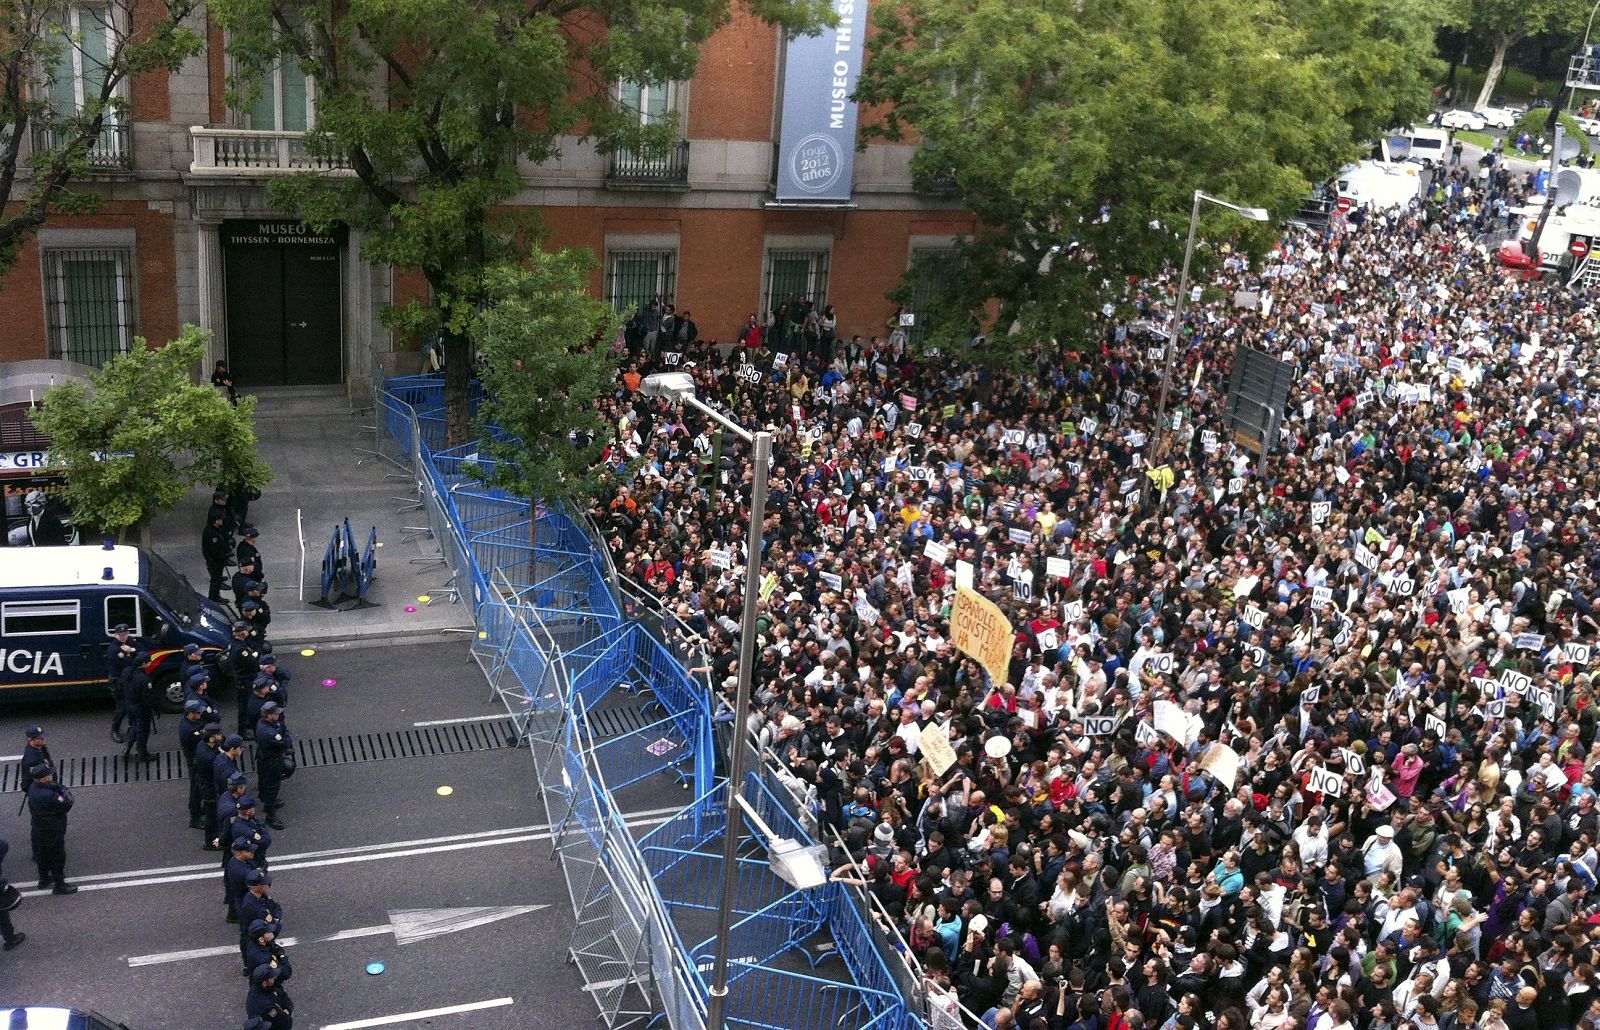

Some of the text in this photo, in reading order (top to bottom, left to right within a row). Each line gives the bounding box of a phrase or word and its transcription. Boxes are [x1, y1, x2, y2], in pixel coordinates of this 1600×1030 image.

[830, 61, 848, 128] MUSEO
[802, 145, 826, 159] 1992
[801, 155, 829, 170] 2012
[802, 167, 831, 181] años
[259, 224, 306, 235] MUSEO
[231, 236, 270, 244] THYSSEN
[278, 236, 335, 244] BORNEMISZA
[1150, 350, 1162, 358] NO
[740, 365, 752, 377] NO
[1123, 391, 1138, 404] NO
[1005, 431, 1023, 443] NO
[911, 469, 925, 480] NO
[1230, 480, 1241, 491] NO
[1363, 552, 1377, 569] NO
[1014, 583, 1030, 599] NO
[1390, 580, 1412, 593] NO
[1065, 603, 1080, 619] NO
[1245, 606, 1262, 627] NO
[958, 630, 968, 650] HA
[1566, 646, 1586, 661] NO
[1501, 671, 1528, 691] NO
[1086, 718, 1113, 734] NO
[1427, 718, 1445, 739] NO
[1312, 770, 1338, 794] NO
